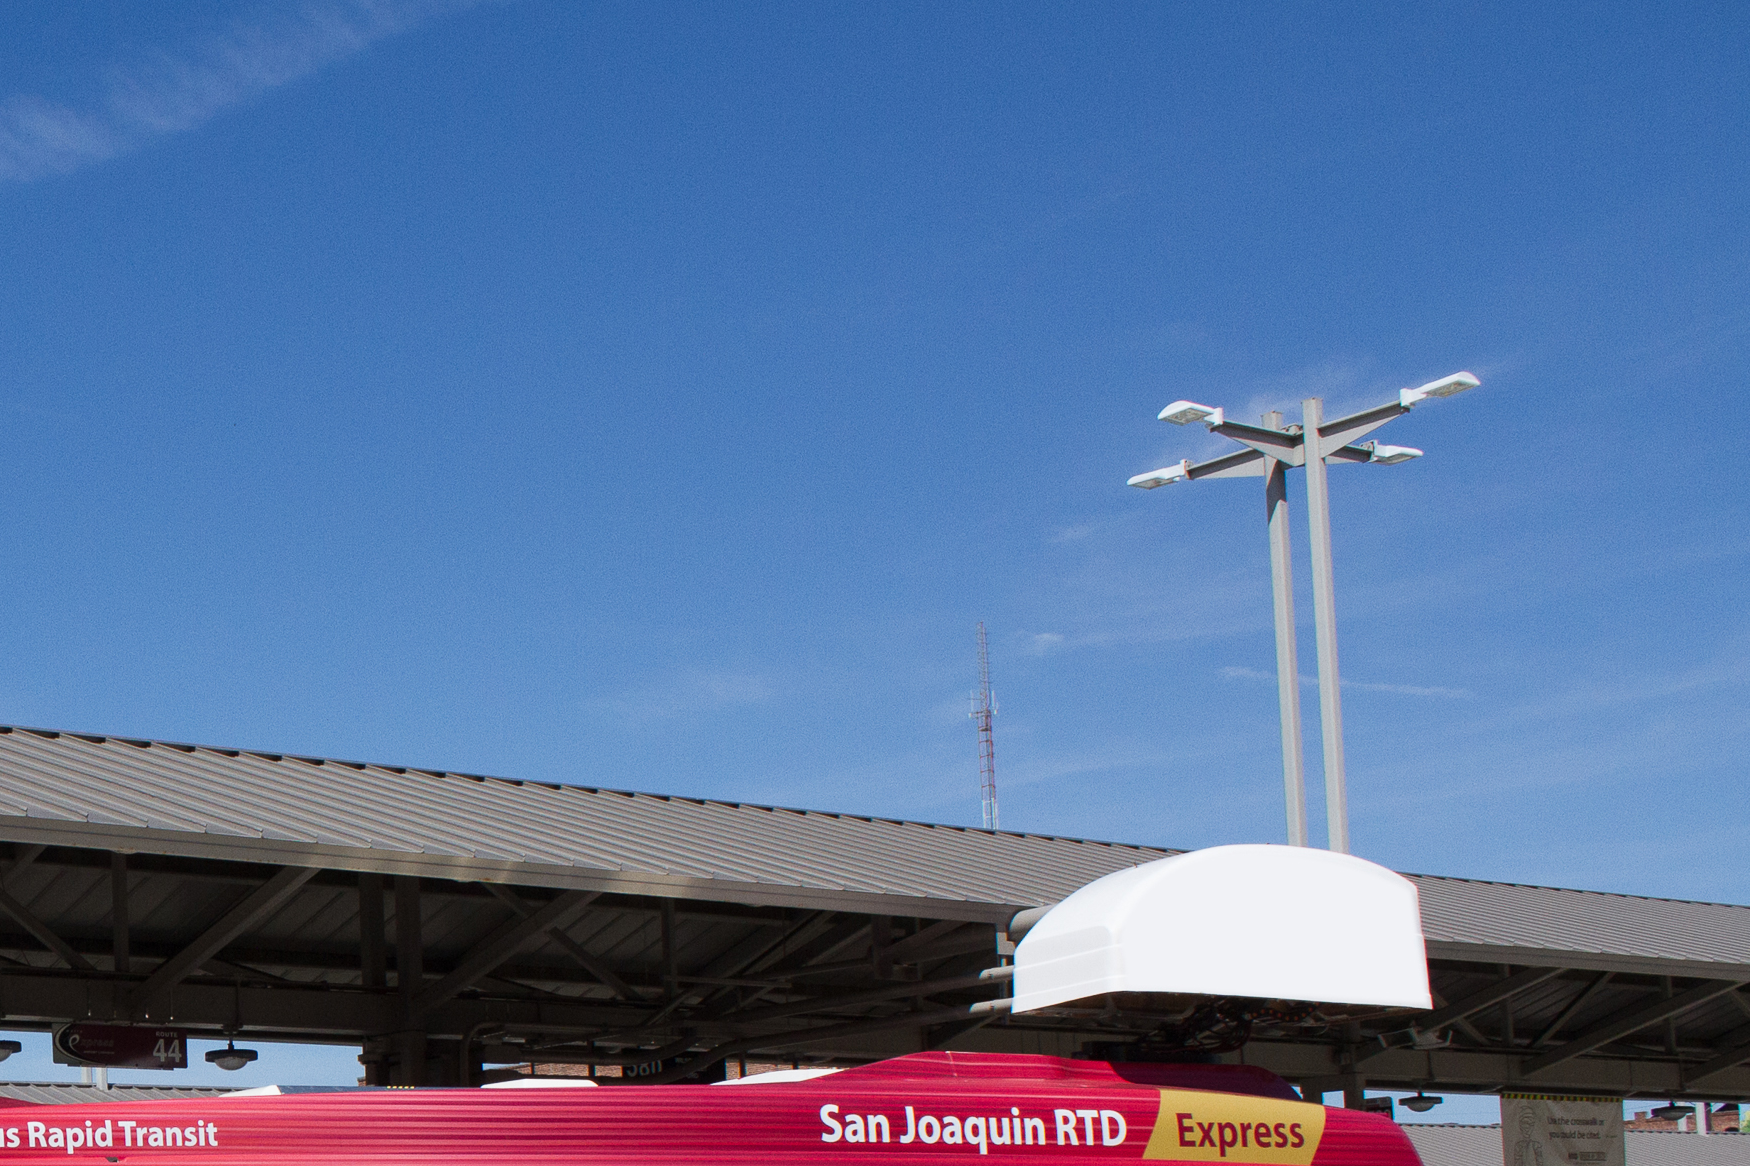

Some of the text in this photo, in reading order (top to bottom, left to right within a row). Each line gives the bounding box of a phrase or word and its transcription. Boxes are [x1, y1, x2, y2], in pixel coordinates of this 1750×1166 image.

[152, 1039, 182, 1062] 44
[27, 1120, 113, 1154] Rapid
[118, 1120, 218, 1147] Transit
[820, 1104, 1127, 1154] San Joaquin RTD
[1176, 1112, 1305, 1157] Express
